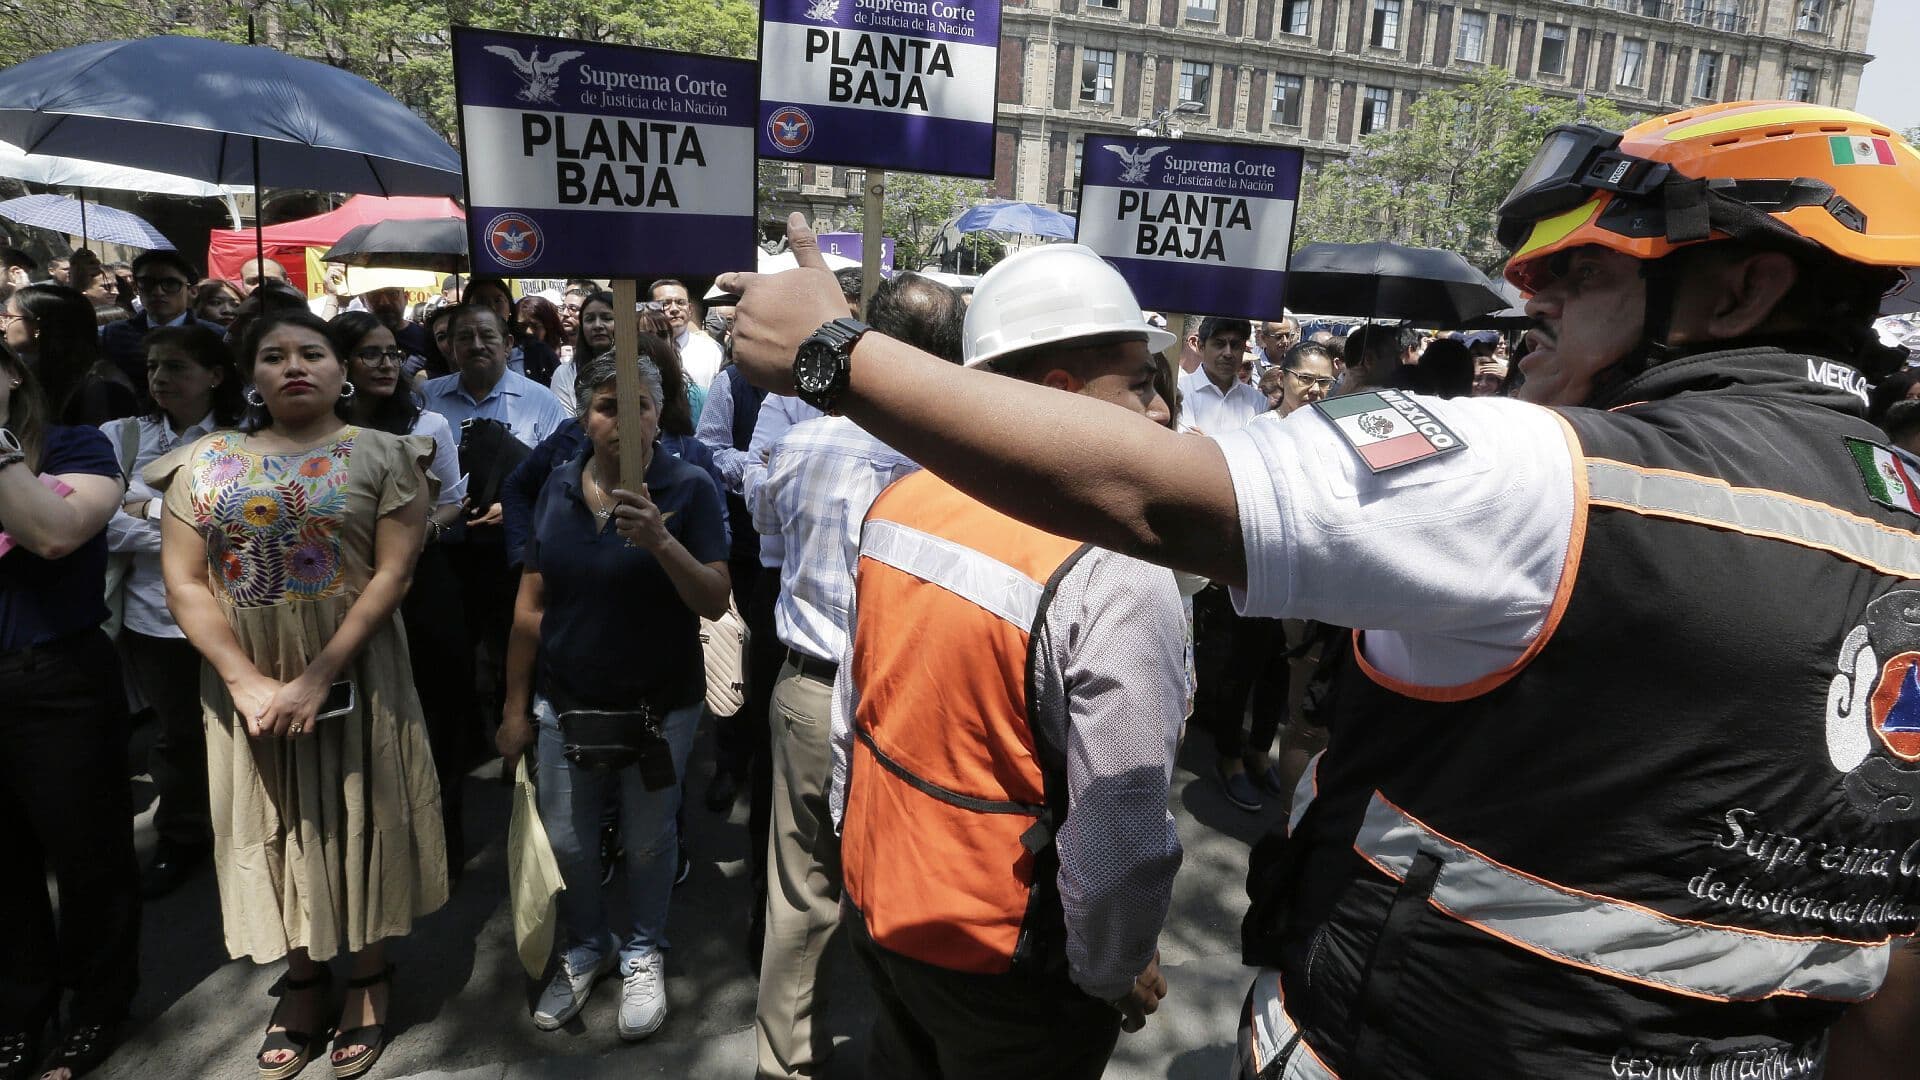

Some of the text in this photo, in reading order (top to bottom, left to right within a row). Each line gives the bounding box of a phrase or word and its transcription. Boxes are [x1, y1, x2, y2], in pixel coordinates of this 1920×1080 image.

[854, 11, 975, 37] de Justicia de la Nación
[932, 2, 976, 22] Corte
[805, 28, 954, 78] PLANTA
[579, 64, 728, 98] Suprema Corte
[829, 67, 929, 111] BAJA
[580, 89, 728, 117] de Justicia de la Nación
[522, 113, 706, 167] PLANTA
[1163, 172, 1274, 192] de Justicia de la Nación
[1164, 155, 1276, 178] Suprema Corte
[1610, 161, 1629, 182] MSA
[557, 161, 680, 208] BAJA
[1117, 190, 1252, 230] PLANTA
[1136, 224, 1226, 261] BAJA
[1713, 808, 1896, 877] Suprema
